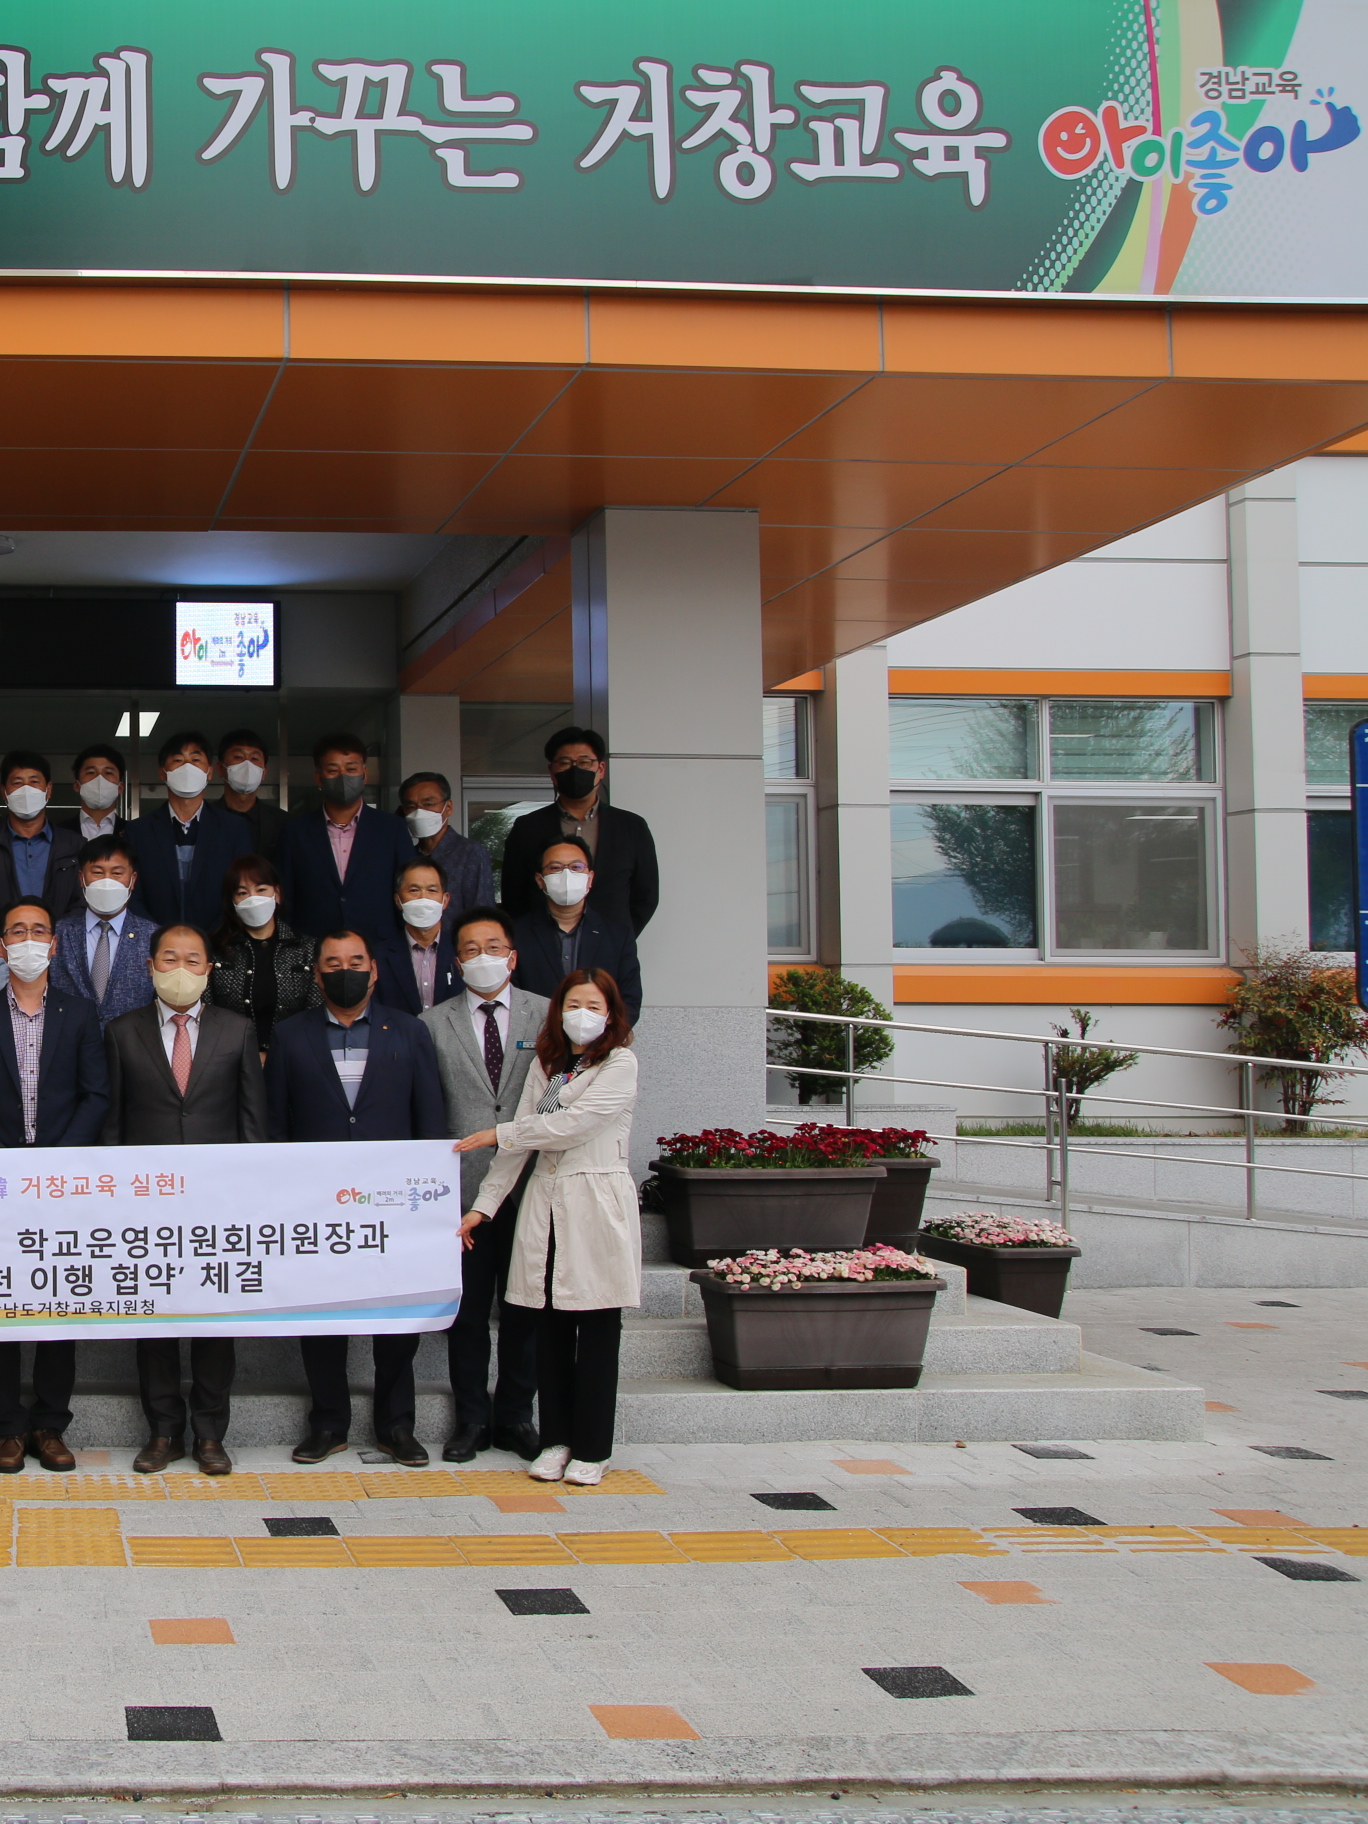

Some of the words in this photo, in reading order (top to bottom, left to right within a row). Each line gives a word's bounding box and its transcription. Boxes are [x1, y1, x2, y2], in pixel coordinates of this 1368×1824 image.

[1198, 69, 1303, 101] 경남교육
[199, 49, 536, 194] 가꾸는
[574, 60, 1008, 208] 거창교육
[1040, 99, 1362, 216] 아이좋아
[20, 1174, 117, 1200] 거창교육
[130, 1173, 185, 1197] 실현!
[405, 1177, 437, 1186] 경남교육
[17, 1220, 389, 1262] 학교운영위원회위원장과
[30, 1264, 93, 1298] 이행
[200, 1260, 264, 1294] 체결
